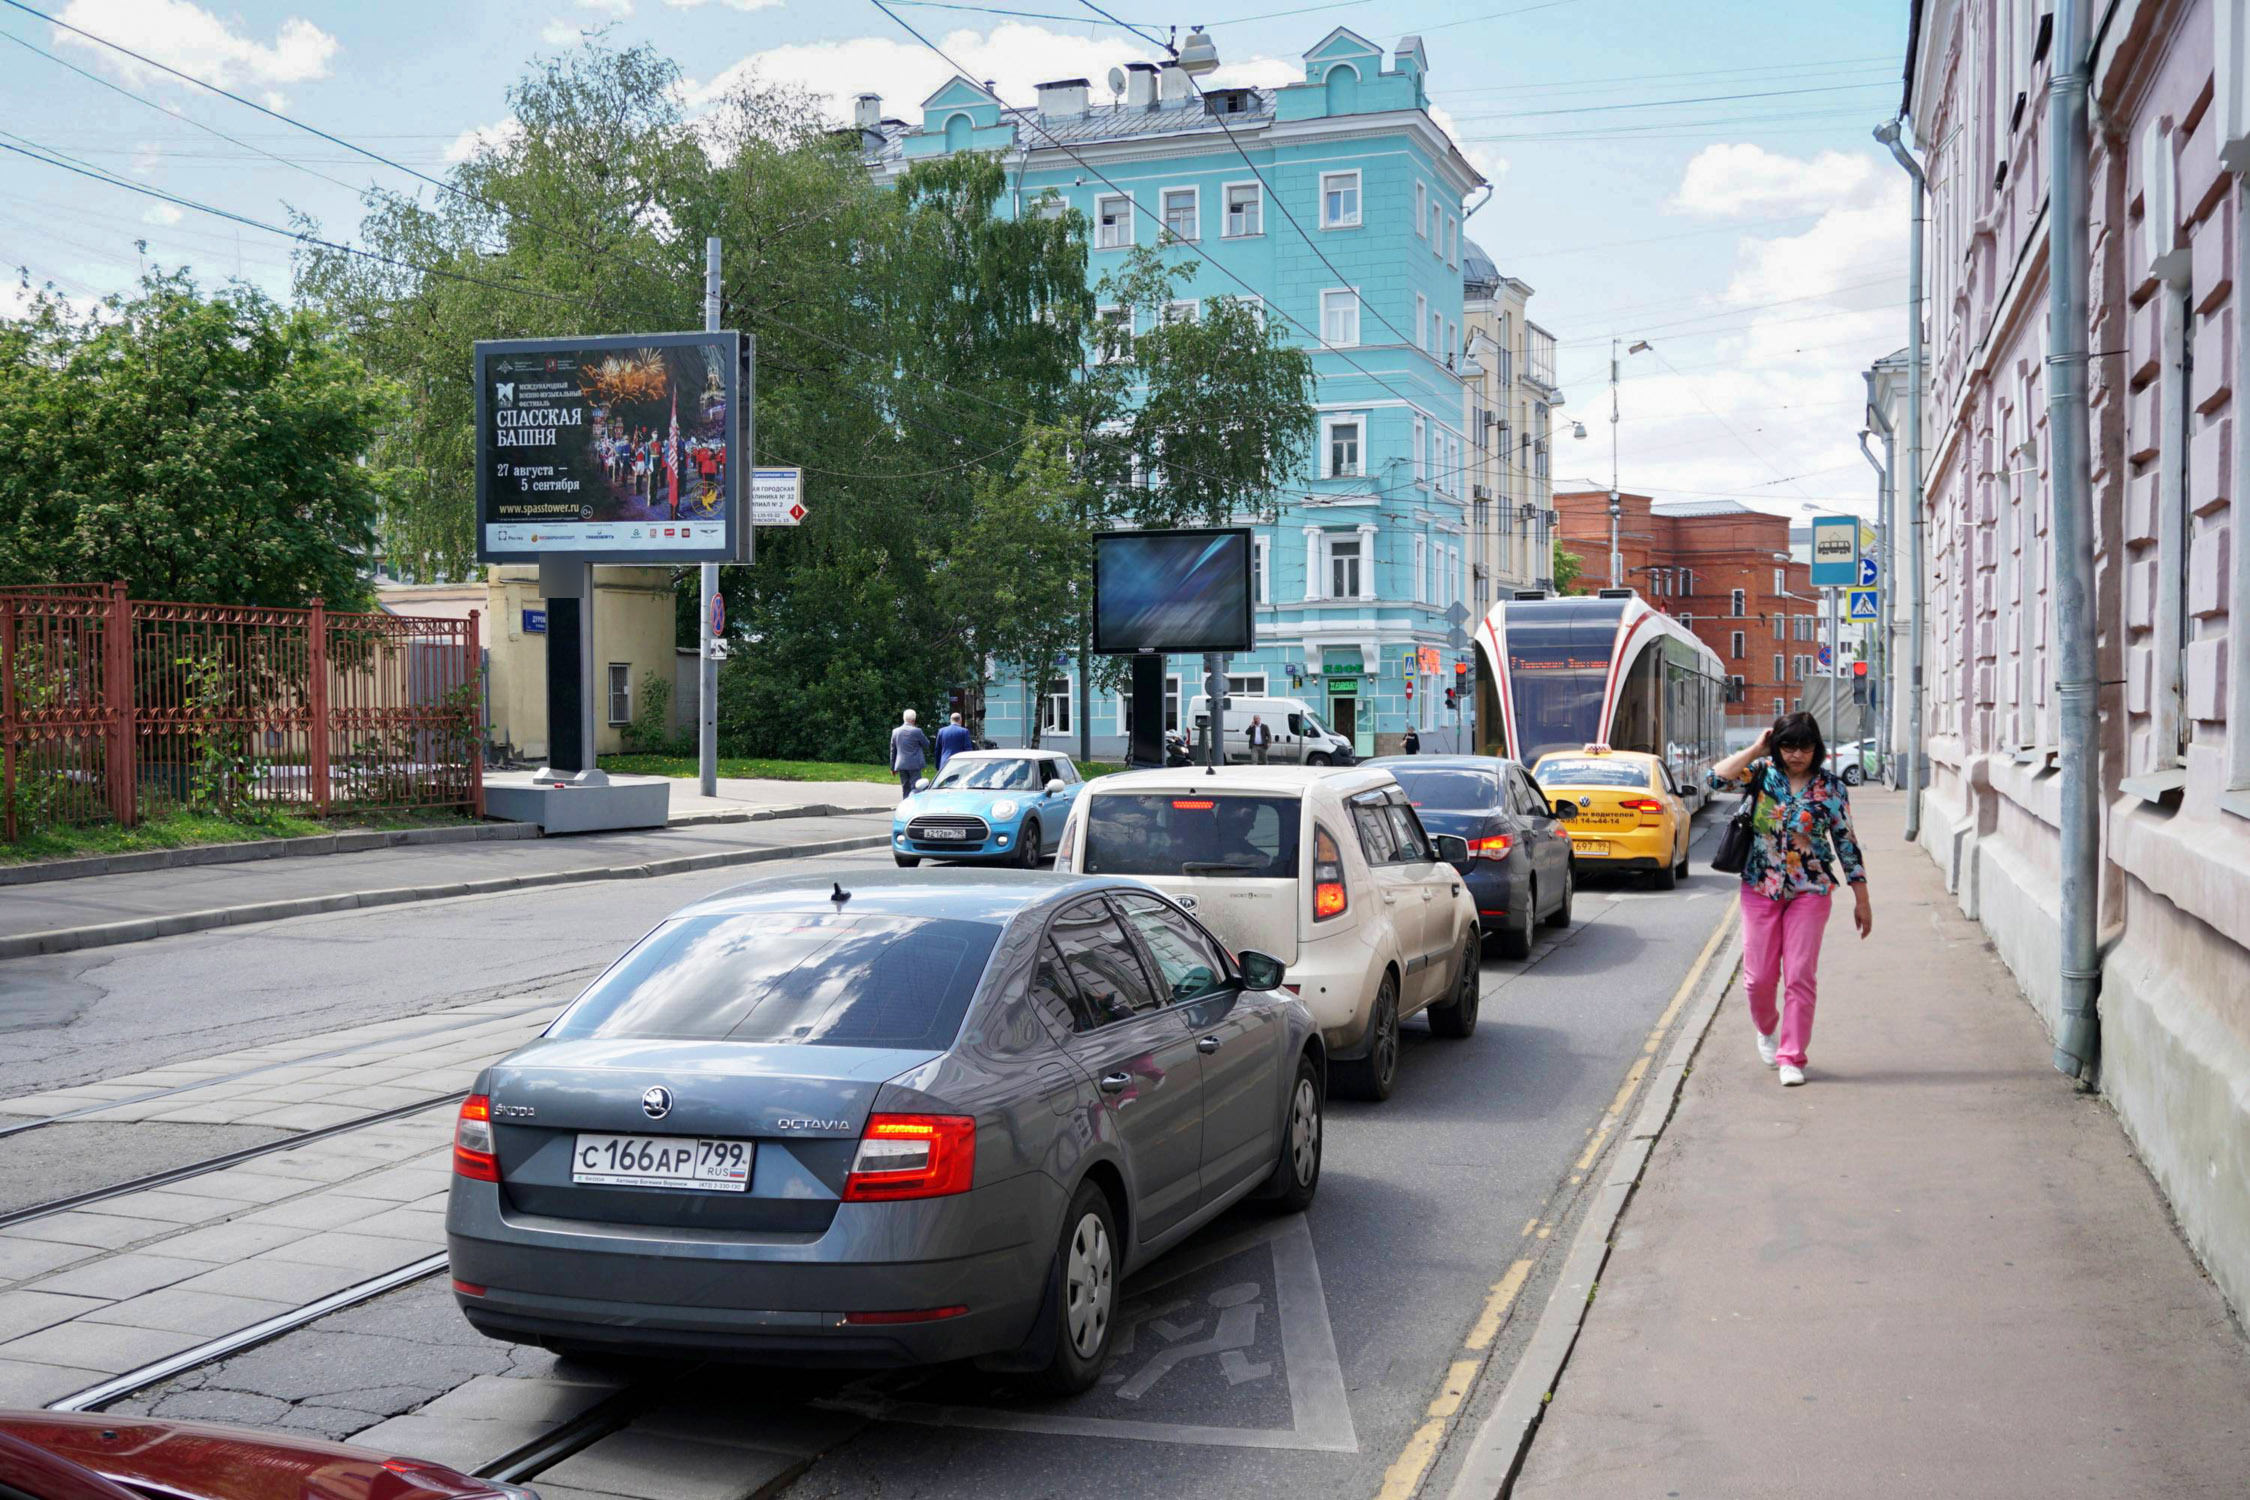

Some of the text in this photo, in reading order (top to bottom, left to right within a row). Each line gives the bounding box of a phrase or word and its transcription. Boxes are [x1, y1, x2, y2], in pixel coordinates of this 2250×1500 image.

[497, 408, 582, 427] СПАССКАЯ
[497, 428, 557, 447] БАШНЯ
[497, 464, 509, 476] 27
[513, 466, 554, 478] августа
[521, 478, 580, 493] 5 сентября
[499, 503, 579, 516] www.spasstower.ru
[494, 1103, 536, 1117] ŠKODA
[778, 1118, 850, 1130] OCTAVIA
[582, 1139, 743, 1173] С166АР 799
[707, 1167, 729, 1177] RUS
